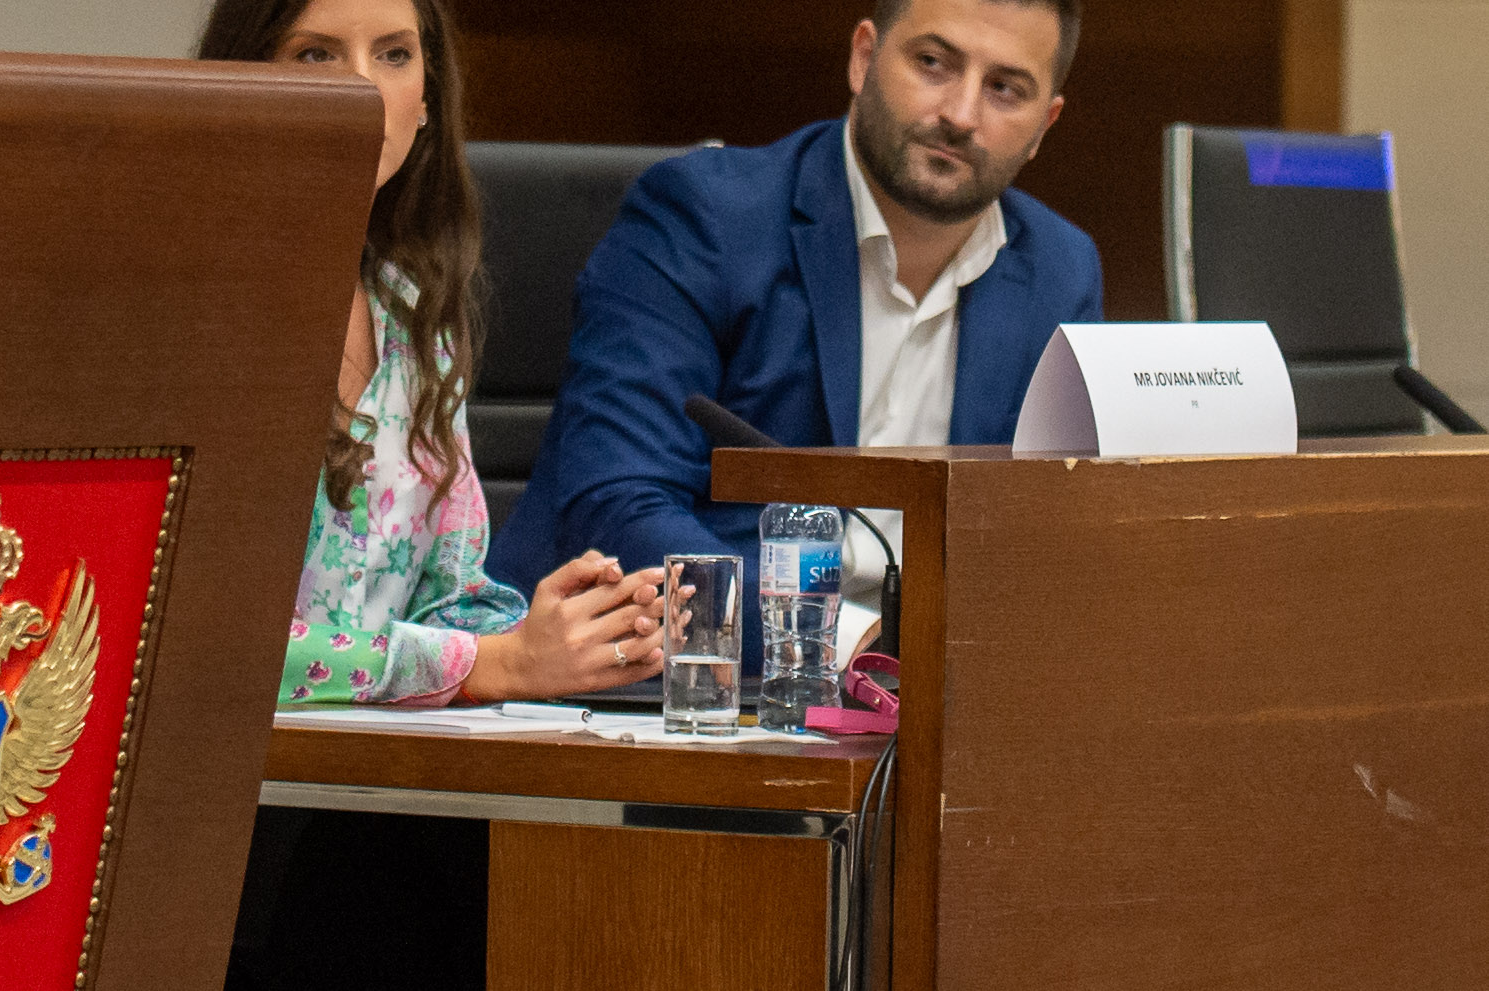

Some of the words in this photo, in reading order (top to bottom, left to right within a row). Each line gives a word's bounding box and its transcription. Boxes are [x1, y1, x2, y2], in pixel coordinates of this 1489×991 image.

[1134, 372, 1153, 387] MR
[1153, 371, 1196, 387] JOVANA
[1196, 366, 1244, 387] NIKČEVIĆ
